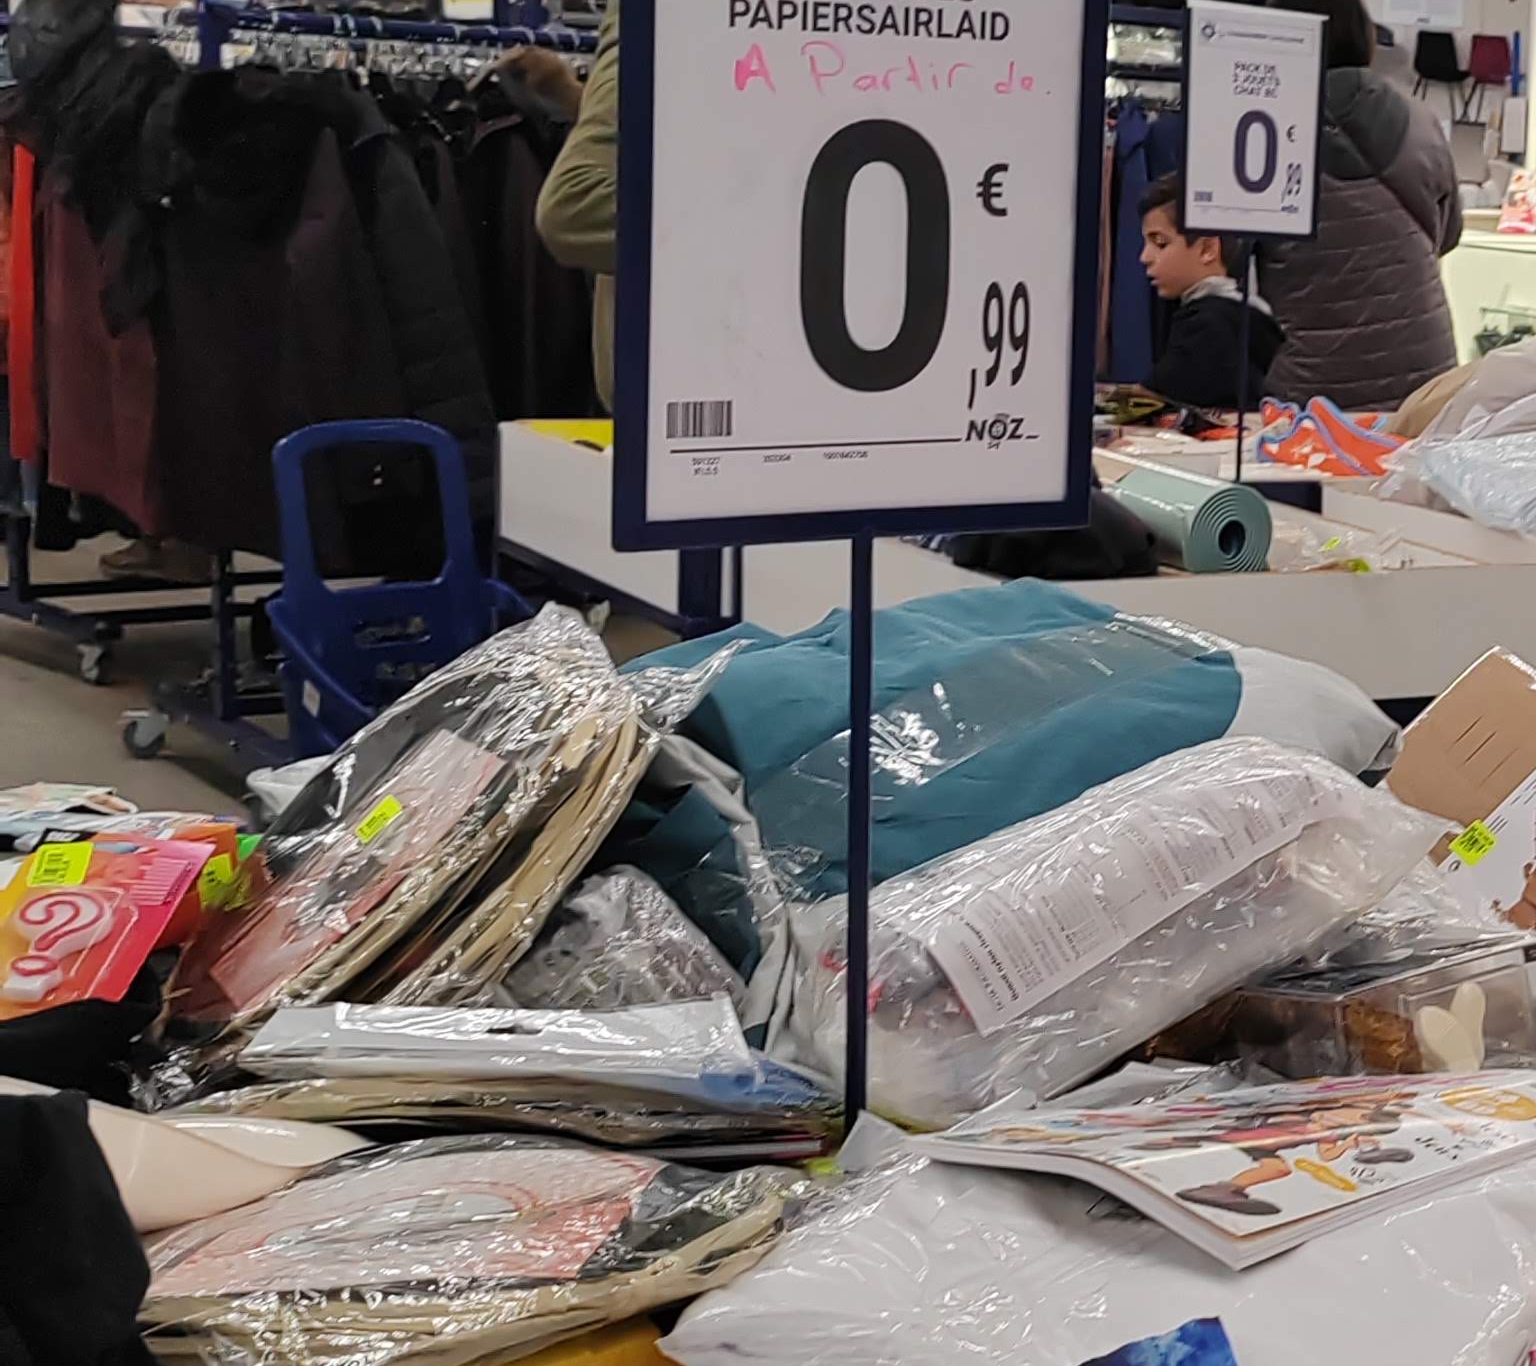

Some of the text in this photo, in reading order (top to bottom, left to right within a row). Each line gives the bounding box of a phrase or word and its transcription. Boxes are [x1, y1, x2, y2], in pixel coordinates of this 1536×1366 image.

[734, 43, 777, 93] A
[800, 40, 974, 92] Partir
[976, 164, 1010, 218] €
[1233, 110, 1279, 194] 0
[801, 119, 951, 393] 0
[967, 280, 1031, 410] ,99
